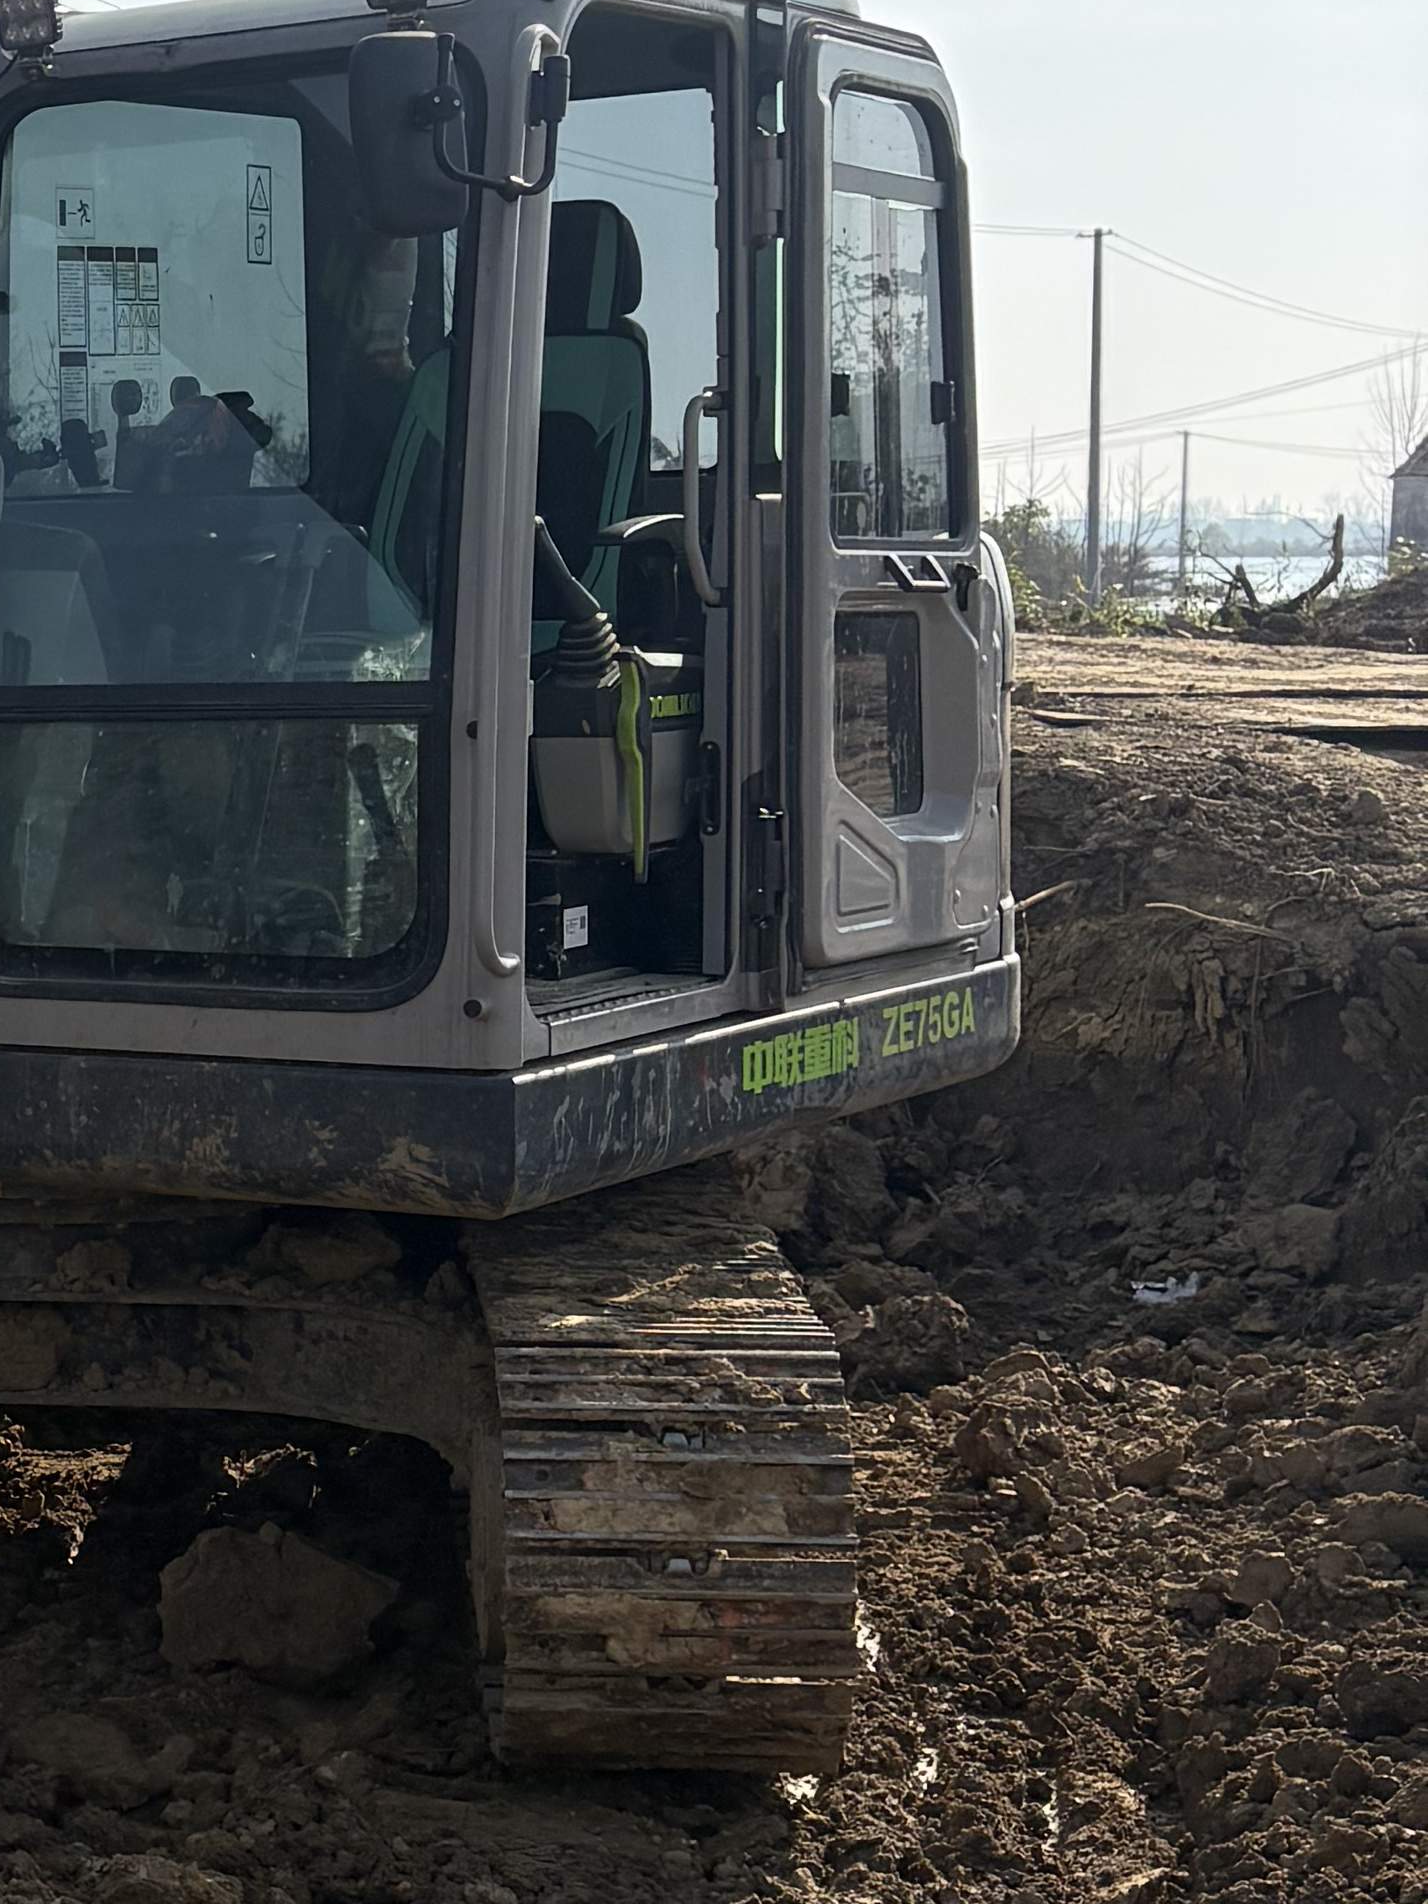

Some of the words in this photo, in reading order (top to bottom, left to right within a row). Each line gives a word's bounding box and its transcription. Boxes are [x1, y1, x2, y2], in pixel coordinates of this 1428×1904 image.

[743, 1017, 859, 1094] 中联重科
[882, 987, 975, 1056] ZE75GA
